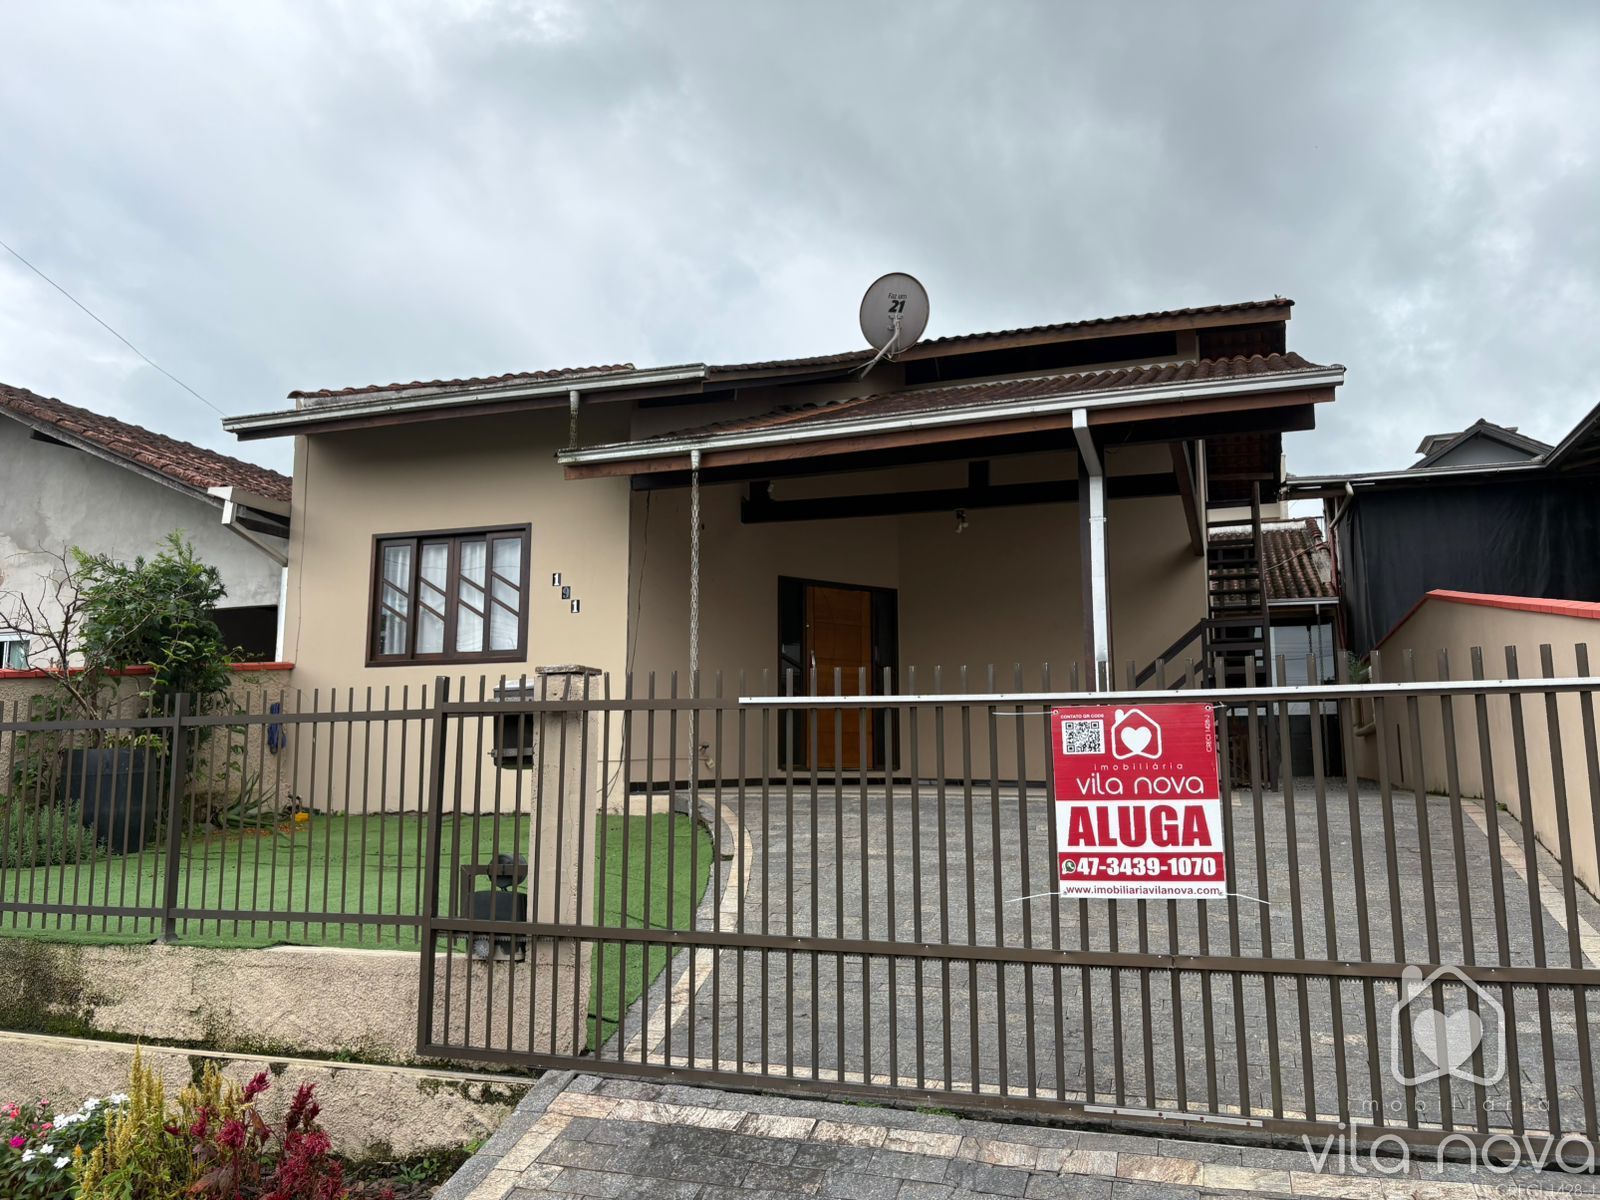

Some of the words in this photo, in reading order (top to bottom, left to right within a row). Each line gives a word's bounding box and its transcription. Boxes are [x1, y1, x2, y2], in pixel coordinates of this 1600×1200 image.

[888, 300, 906, 313] 21
[1094, 763, 1183, 771] imobiliária
[1076, 772, 1124, 795] vila
[1133, 776, 1204, 795] nova
[1067, 804, 1213, 848] ALUGA
[1076, 857, 1217, 877] 47-3439-1070
[1066, 885, 1220, 895] www.imobiliariavilanova.com
